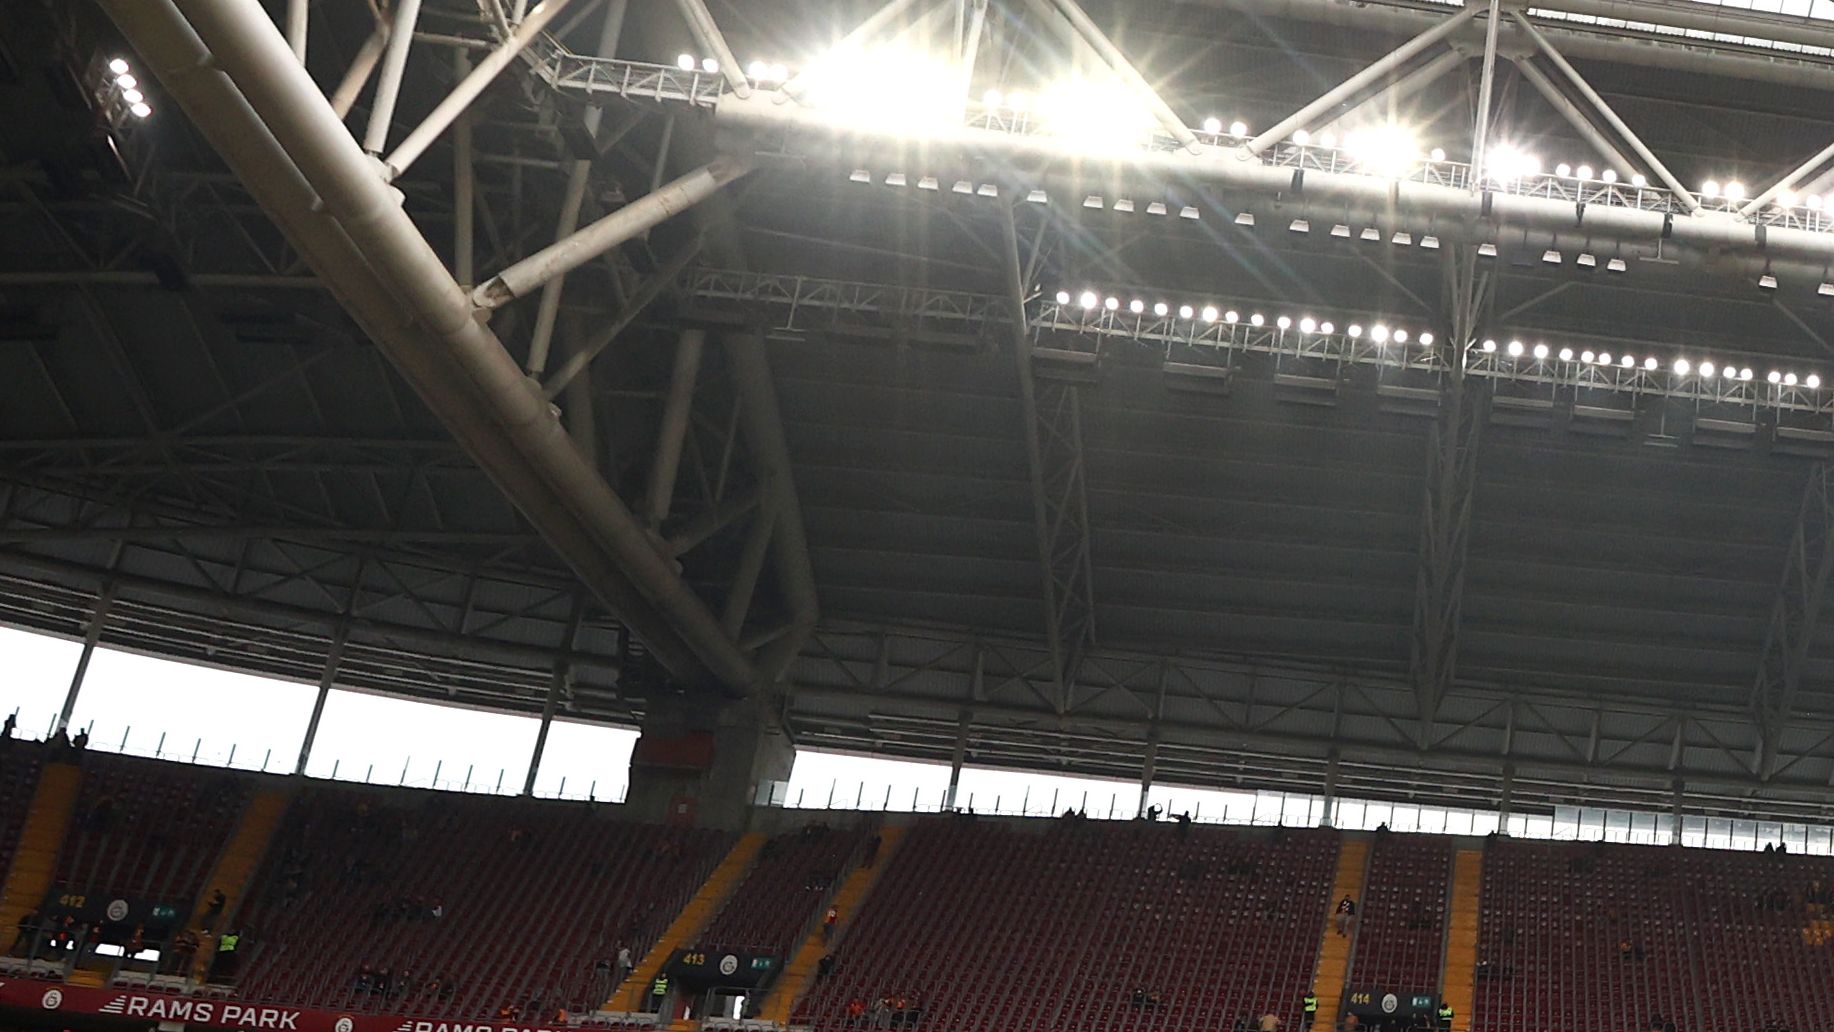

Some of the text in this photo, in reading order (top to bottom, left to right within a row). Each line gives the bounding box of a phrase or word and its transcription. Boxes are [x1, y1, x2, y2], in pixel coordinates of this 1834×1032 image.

[682, 952, 706, 966] 413
[1350, 992, 1371, 1005] 414
[127, 995, 300, 1031] RAMS PARK
